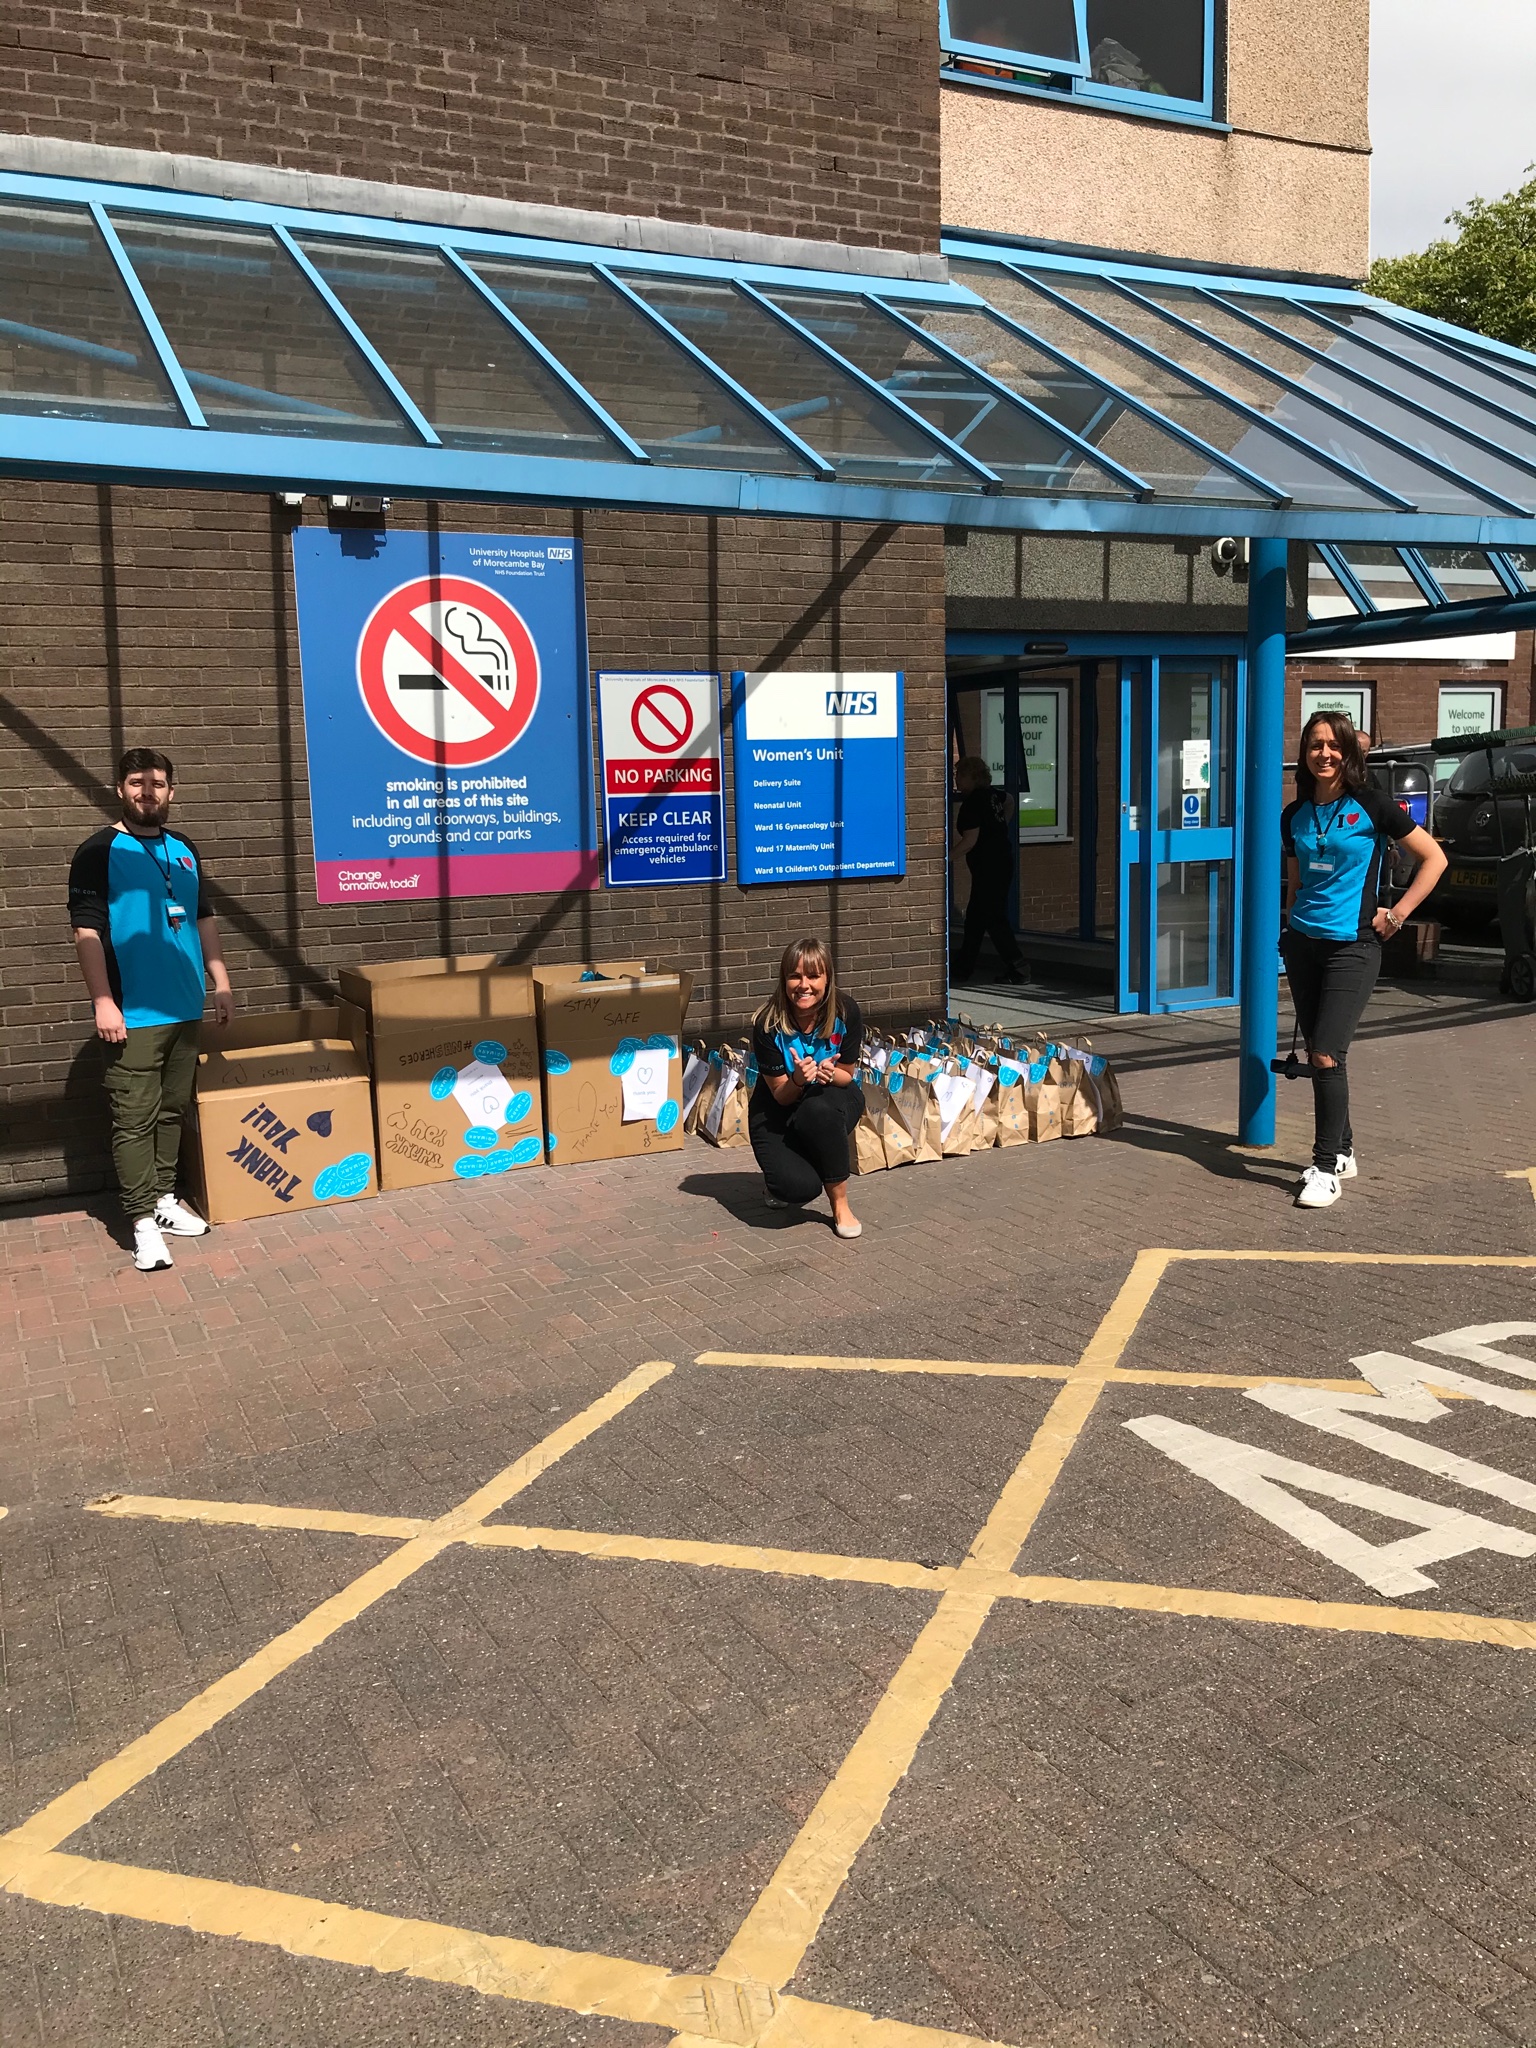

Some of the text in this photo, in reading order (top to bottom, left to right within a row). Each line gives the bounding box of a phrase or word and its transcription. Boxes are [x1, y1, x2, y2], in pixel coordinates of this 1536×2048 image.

[469, 548, 572, 559] University Hospitals NHS
[473, 558, 545, 570] of Morecambe Bay
[827, 692, 876, 715] NHS
[1317, 701, 1344, 709] Betterlife
[1448, 709, 1486, 720] Welcome
[1451, 724, 1481, 736] to your
[752, 747, 844, 762] Women's Unit
[614, 767, 712, 784] NO PARKING
[386, 776, 527, 793] smoking is prohibited
[753, 779, 801, 788] Delivery Suite
[386, 793, 529, 809] in all areas of this site
[754, 800, 801, 809] Neonatal Unit
[352, 810, 562, 829] including all doorways, buildings,
[618, 811, 712, 827] KEEP CLEAR
[1337, 814, 1345, 828] I
[754, 823, 773, 831] Ward
[785, 822, 828, 831] Gynaecology
[388, 827, 532, 848] grounds and car parks
[622, 832, 711, 844] Access required for
[614, 842, 718, 856] emergency ambulance
[755, 842, 835, 853] Ward 17 Maternity Unit
[649, 854, 686, 864] vehicles
[754, 861, 896, 875] Ward 18 Children's Outpatient Department
[338, 870, 382, 882] Change
[338, 881, 389, 892] tomorrow,
[563, 998, 600, 1013] STAY
[603, 1011, 640, 1026] SAFE
[478, 1048, 505, 1057] PRIMARK
[436, 1070, 453, 1095] PRIMARK
[510, 1095, 529, 1119] PRIMARK
[662, 1104, 674, 1130] PRIMARK
[240, 1102, 301, 1154] YOU!
[571, 1097, 619, 1153] THANK YOU
[468, 1134, 496, 1142] PRIMARK
[385, 1134, 444, 1168] THANK
[516, 1142, 539, 1158] PRIMARK
[340, 1159, 369, 1174] PRIMARK
[490, 1156, 513, 1166] PRIMARK
[226, 1135, 302, 1203] THANK
[319, 1172, 336, 1194] RIMARK
[339, 1176, 366, 1189] PRIMAR
